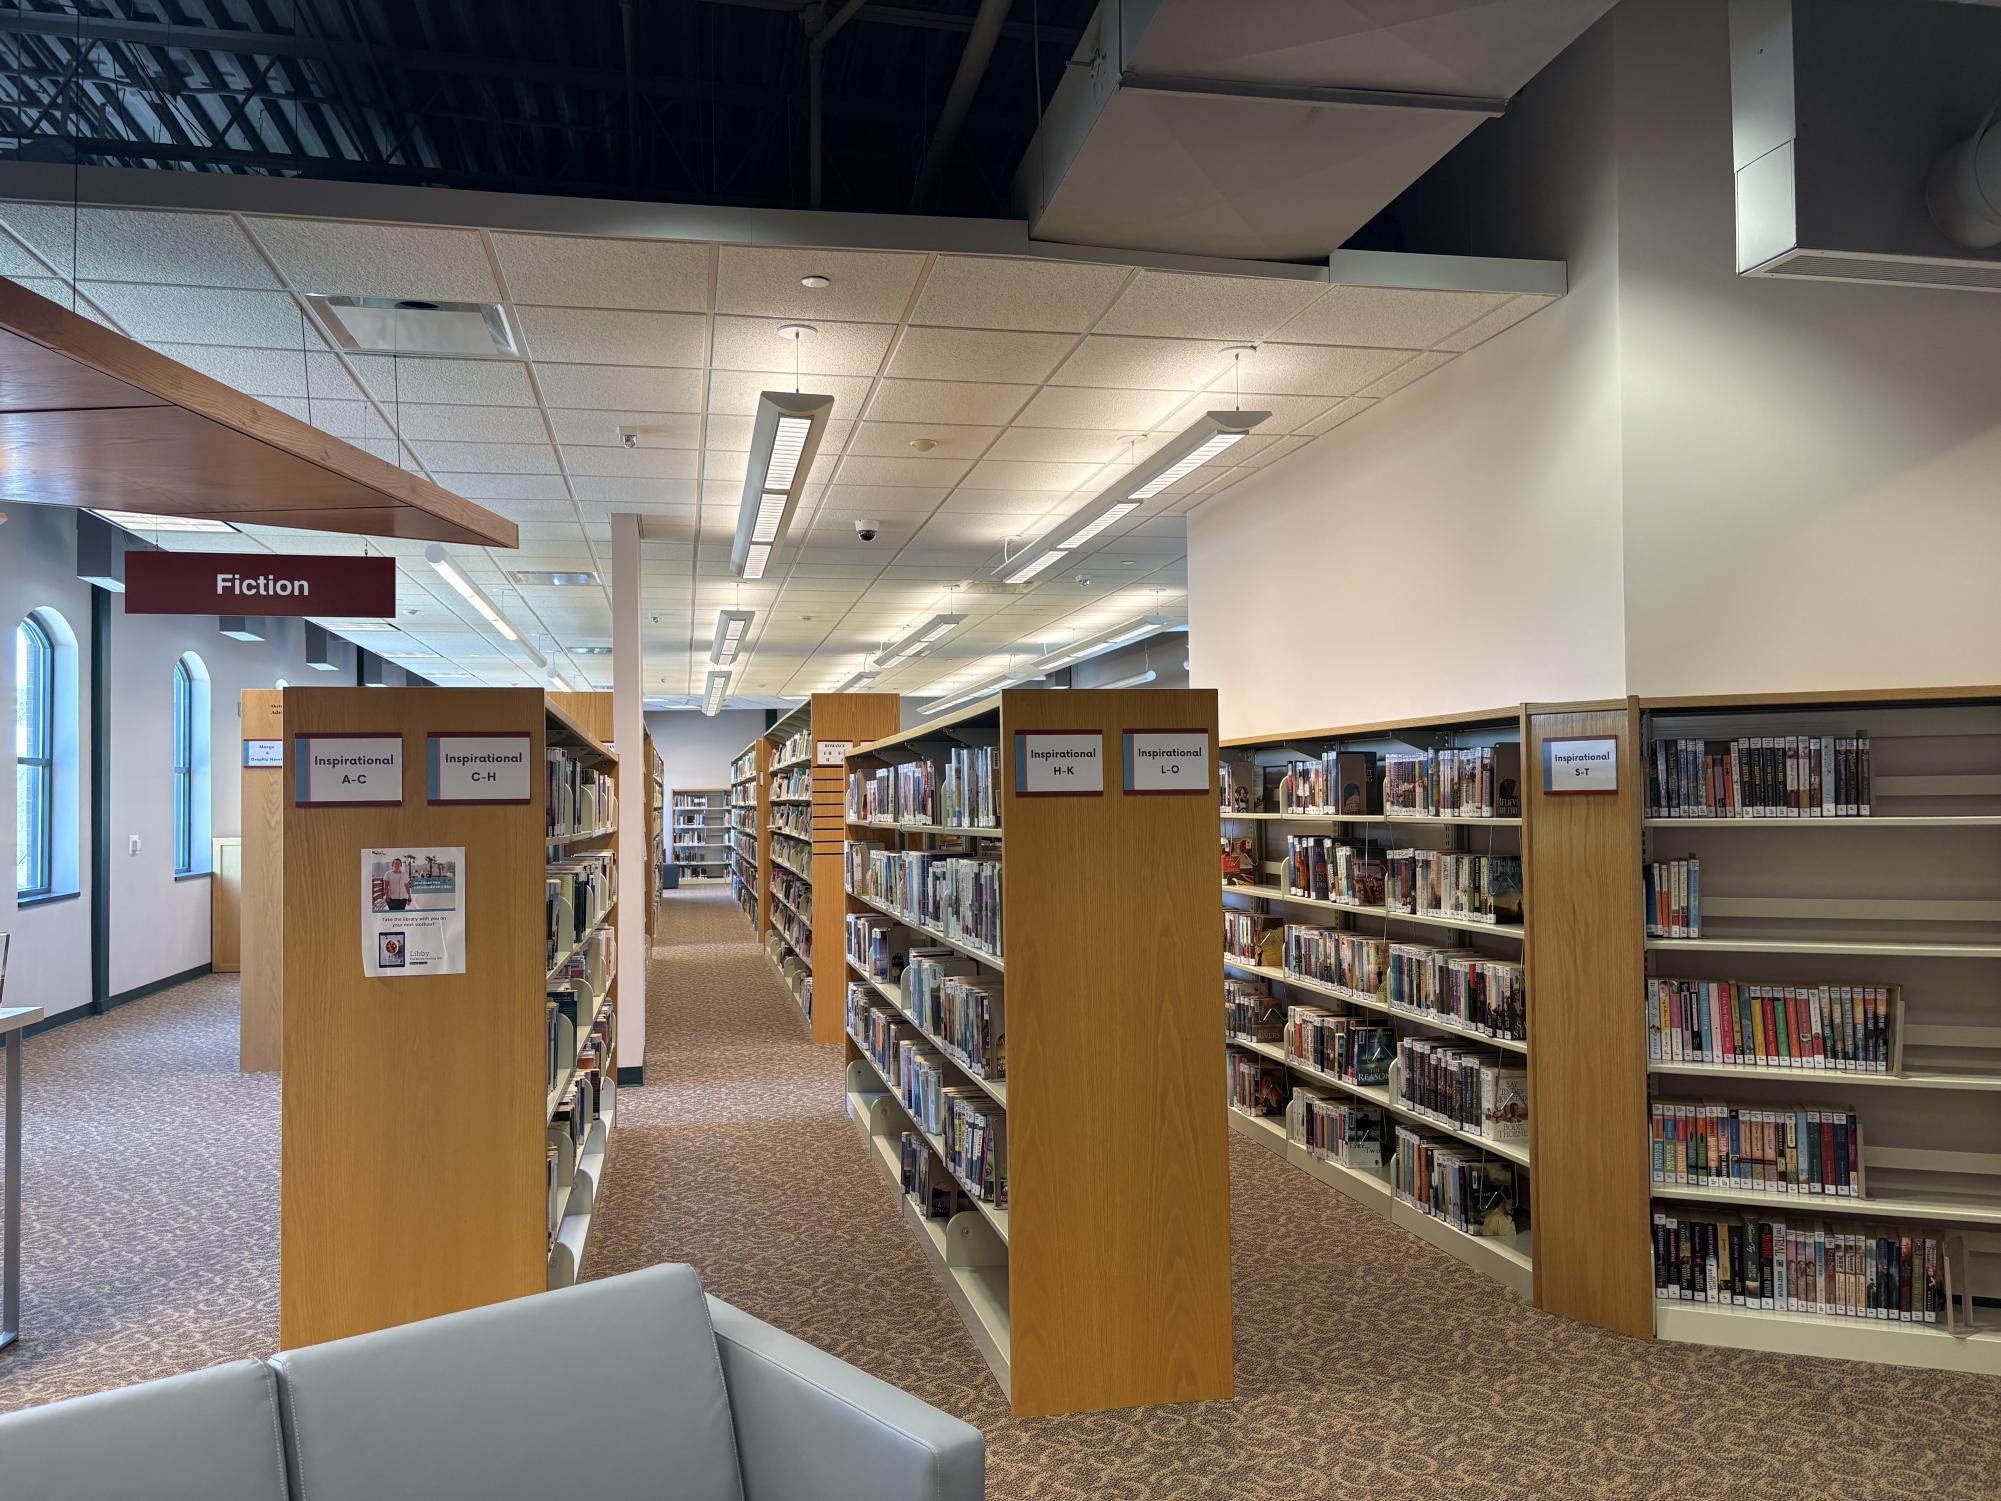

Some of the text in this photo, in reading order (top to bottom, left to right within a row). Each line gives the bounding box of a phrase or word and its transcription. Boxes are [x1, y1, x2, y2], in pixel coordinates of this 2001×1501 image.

[216, 573, 309, 596] Fiction
[445, 752, 523, 767] Inspirational
[1031, 747, 1096, 762] Inspirational
[1138, 746, 1202, 760] Inspirational
[1554, 751, 1610, 764] Inspirational
[314, 753, 395, 769] Inspirational
[1053, 766, 1075, 776] H-K
[1161, 764, 1180, 774] L-O
[1575, 767, 1590, 776] S-T
[341, 774, 367, 785] A-C
[471, 771, 497, 782] C-H
[1774, 1234, 1785, 1257] TRIAL
